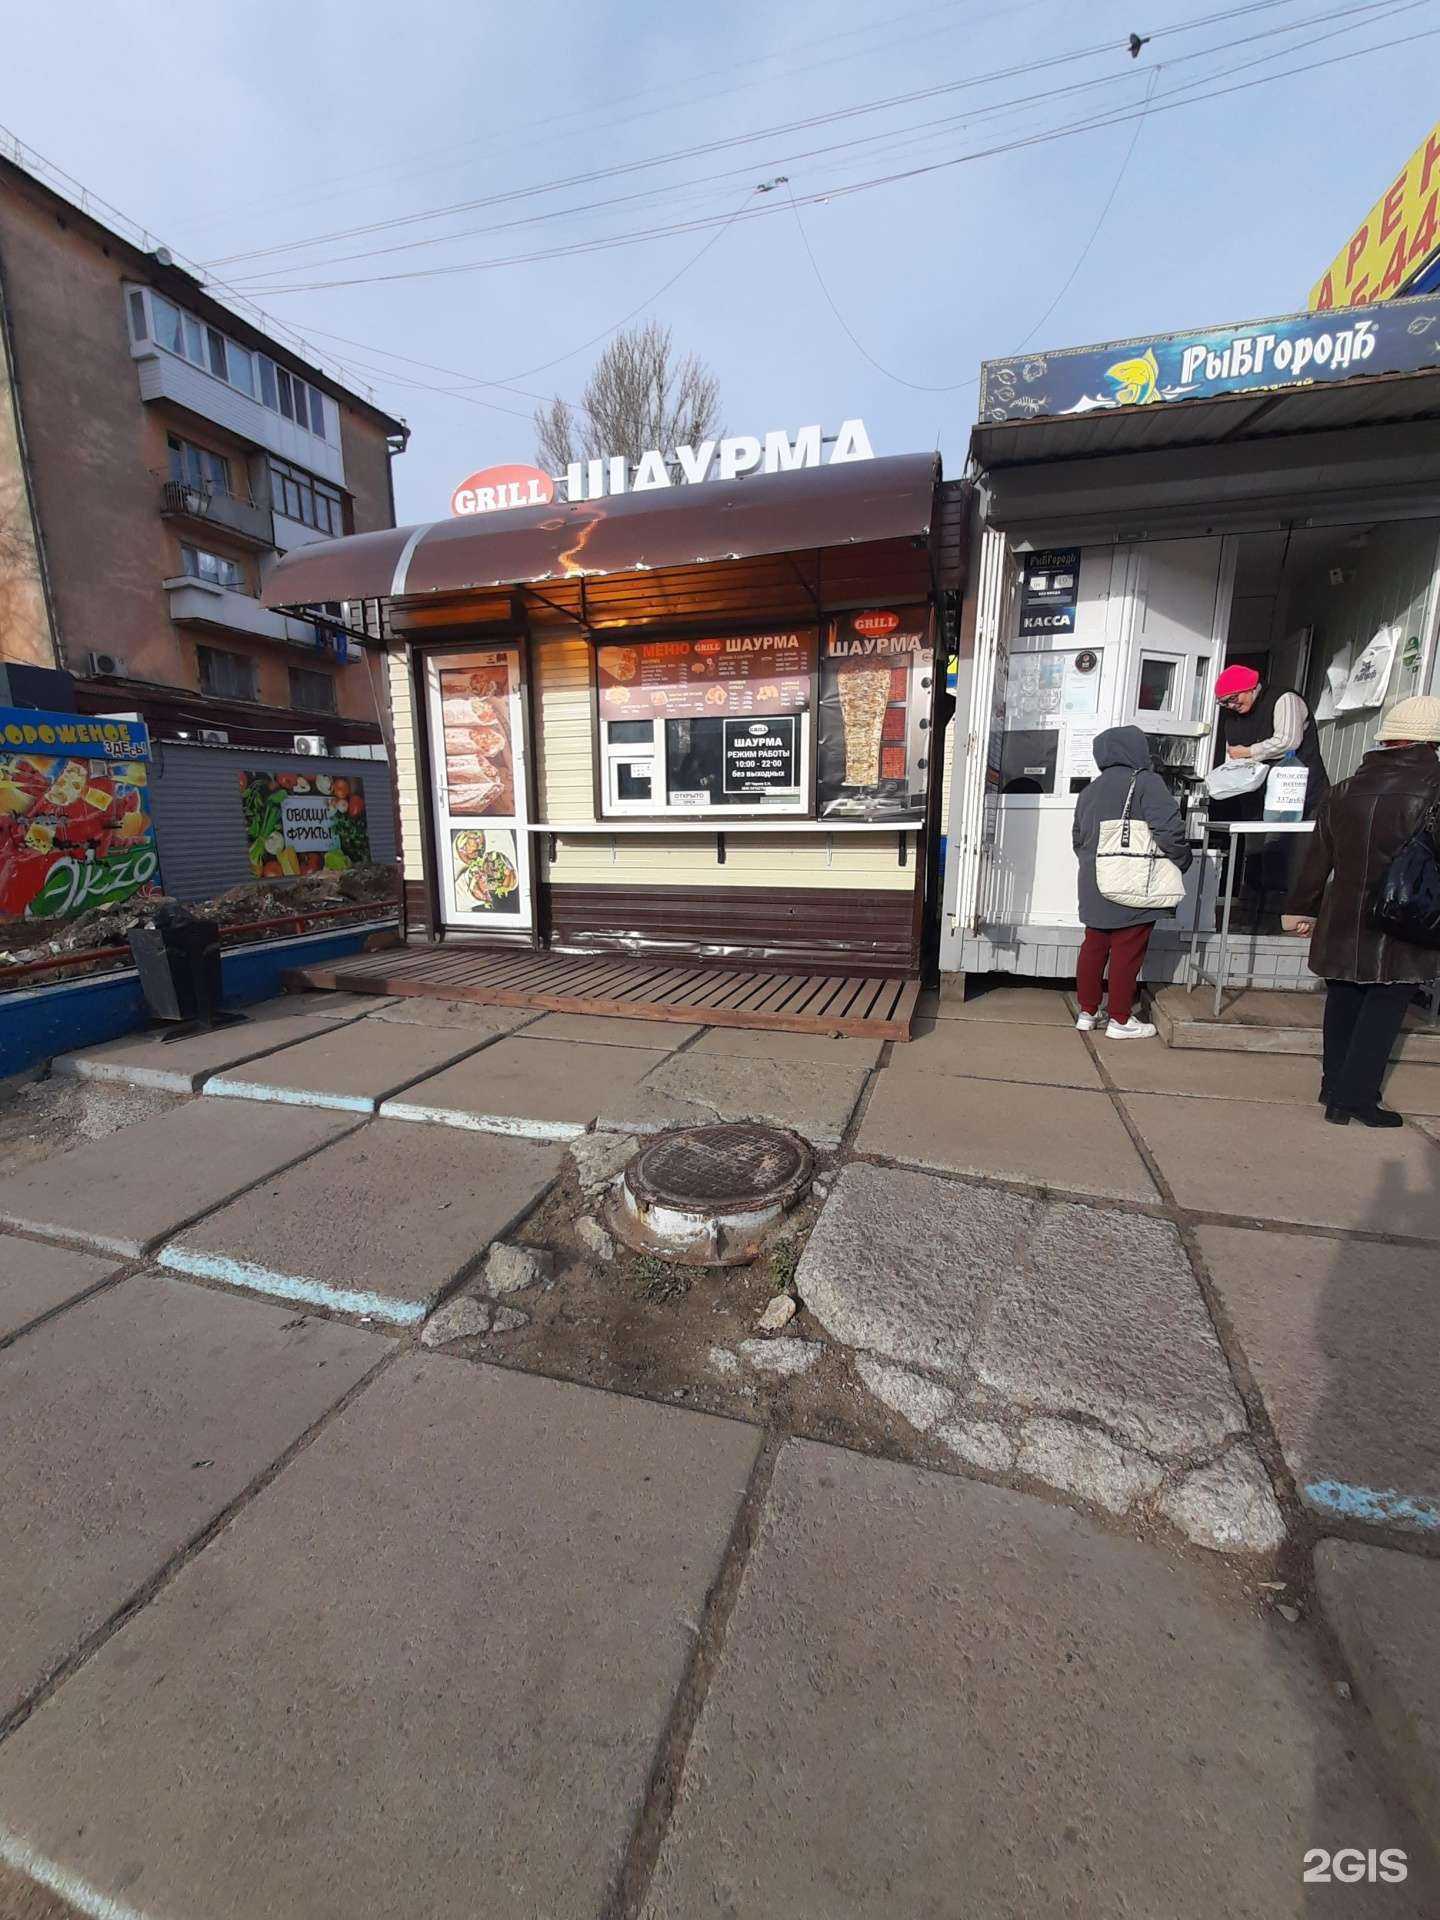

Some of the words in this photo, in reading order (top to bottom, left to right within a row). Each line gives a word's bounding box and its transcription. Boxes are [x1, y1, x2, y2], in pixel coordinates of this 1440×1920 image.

[567, 418, 875, 503] ШАУРМА
[454, 479, 547, 515] GRILL
[854, 615, 898, 630] GRILL
[1024, 615, 1071, 628] КАССА
[643, 642, 690, 657] МЕНЮ
[694, 643, 721, 652] GRILL
[725, 634, 799, 653] ШАУРМА
[829, 635, 922, 657] ШАУРМА
[0, 724, 131, 745] ОРОЖЕНОЕ
[734, 737, 783, 747] ШАУРМА
[727, 750, 757, 758] РЕЖИМ
[758, 749, 790, 757] РАБОТЫ
[746, 770, 785, 778] выходных
[286, 807, 330, 824] ОВОЩИ
[286, 826, 332, 840] ФРУКТЫ
